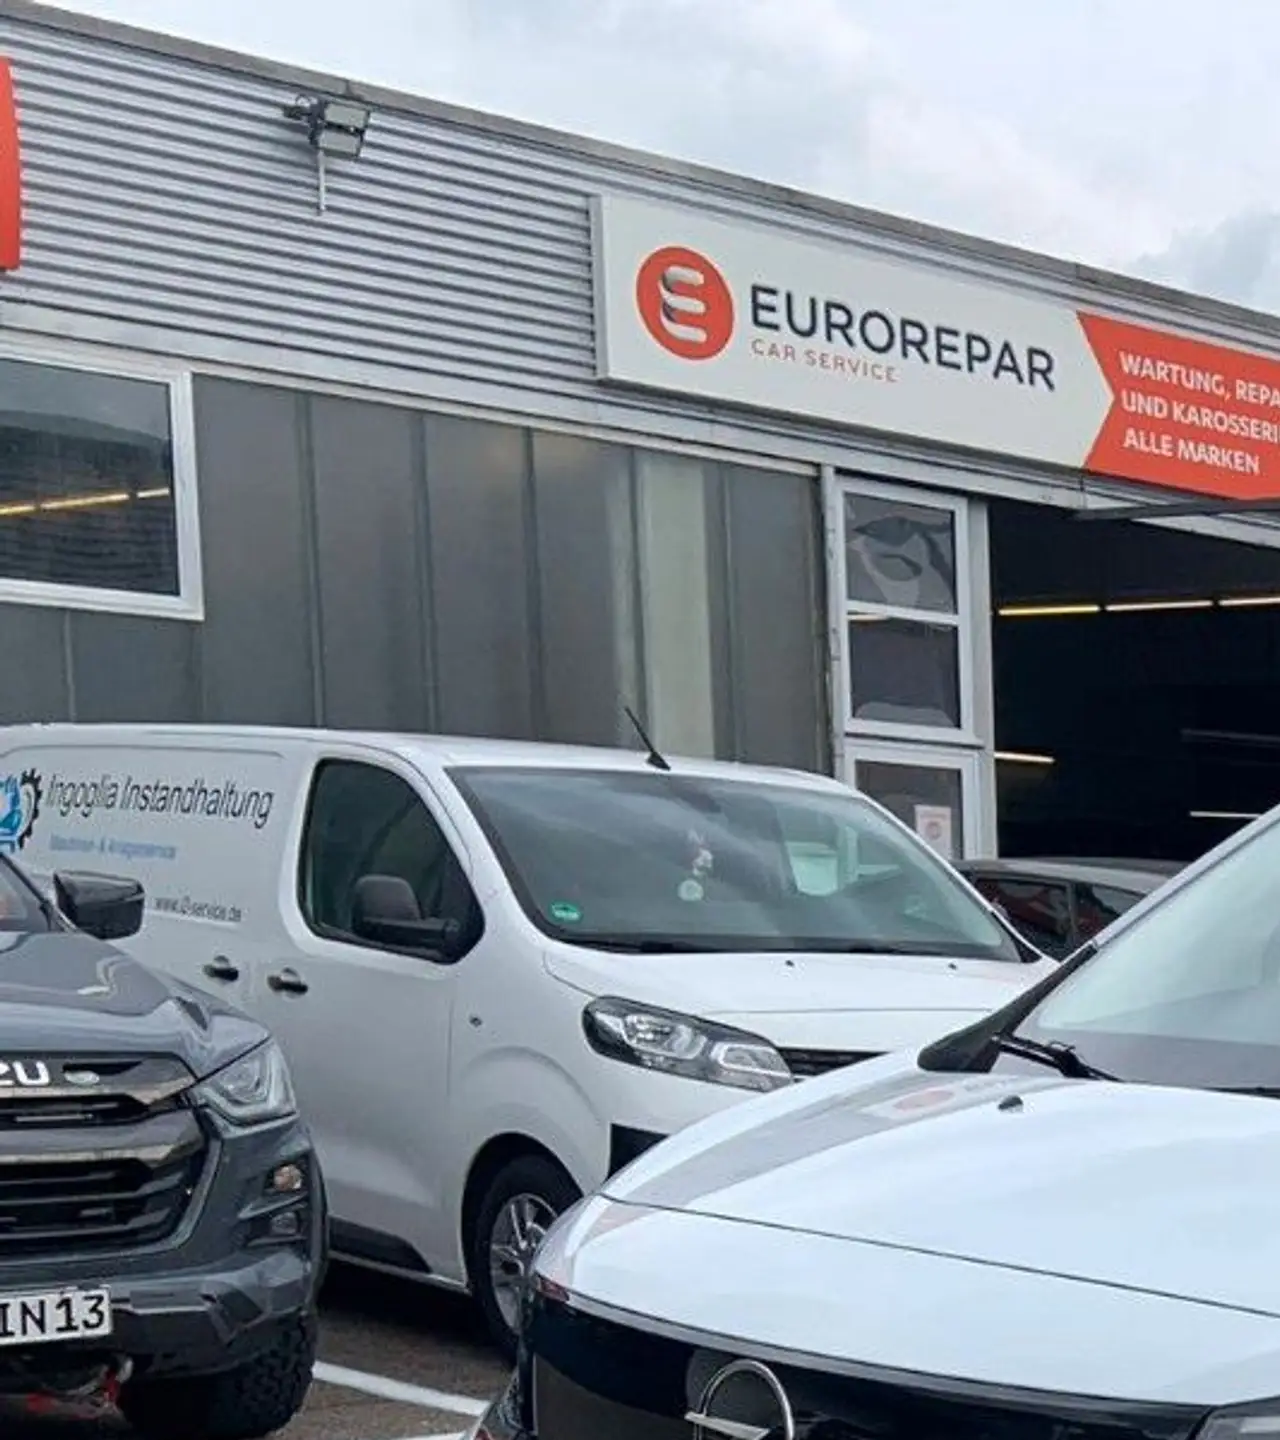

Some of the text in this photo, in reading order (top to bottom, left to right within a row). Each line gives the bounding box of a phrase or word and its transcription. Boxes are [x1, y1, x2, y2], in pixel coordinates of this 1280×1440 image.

[751, 284, 1056, 392] EUROREPAR
[751, 338, 898, 383] CAR SERVICE
[1119, 351, 1231, 401] WARTUNG,
[1121, 389, 1168, 419] UND
[1123, 426, 1260, 475] ALLE MARKEN
[45, 774, 274, 829] Ingoglia Instandhaltung
